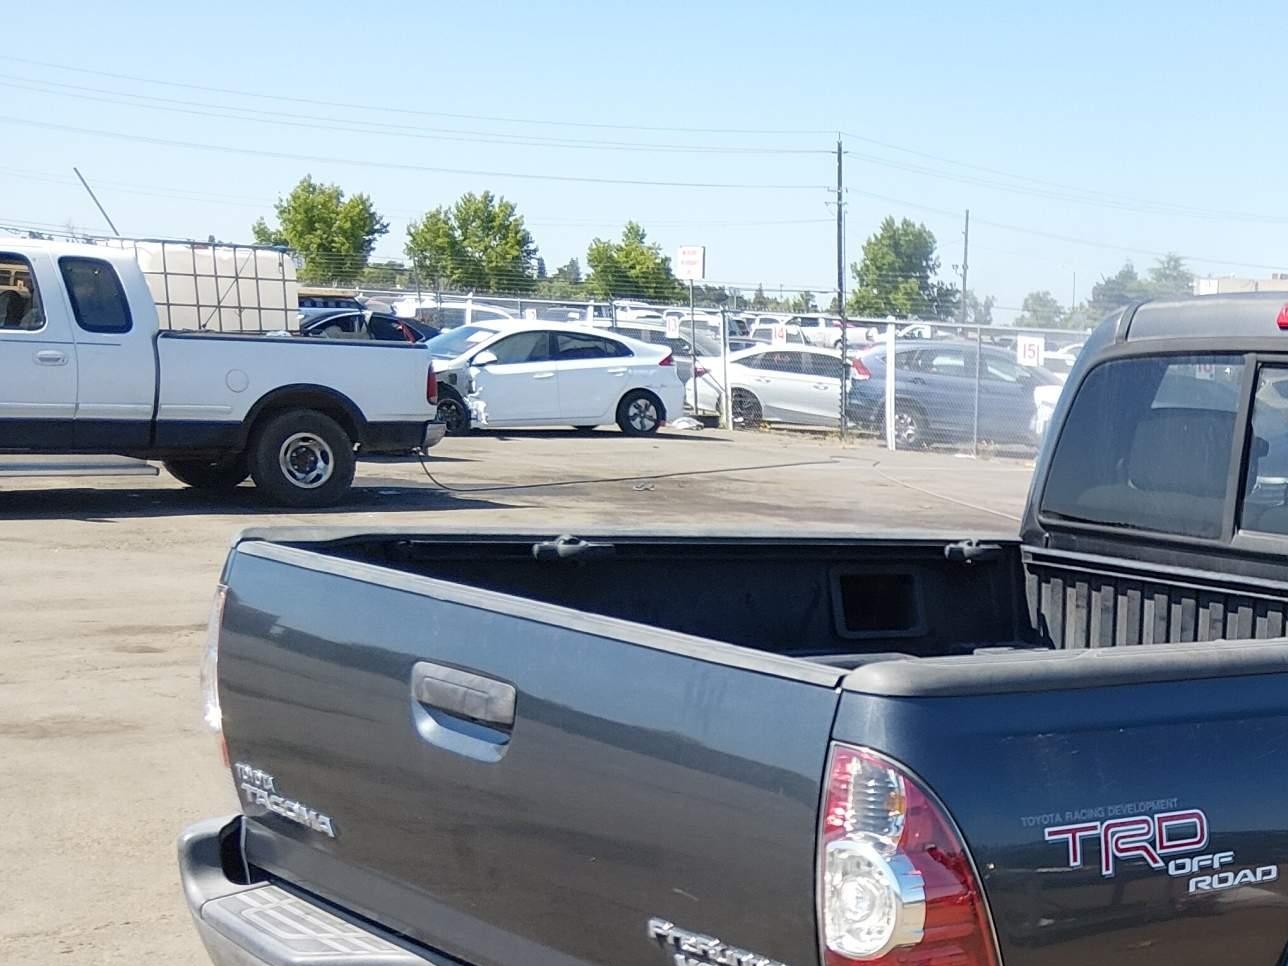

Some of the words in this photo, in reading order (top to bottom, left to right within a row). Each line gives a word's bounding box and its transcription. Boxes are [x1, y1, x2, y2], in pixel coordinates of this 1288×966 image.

[240, 783, 336, 838] TACOMA
[1020, 812, 1063, 828] TOYOTA
[1065, 806, 1105, 822] RACING
[1107, 797, 1179, 818] DEVELOPMENT
[1044, 808, 1208, 877] TRD
[1167, 850, 1236, 877] OFF
[1187, 864, 1279, 894] ROAD
